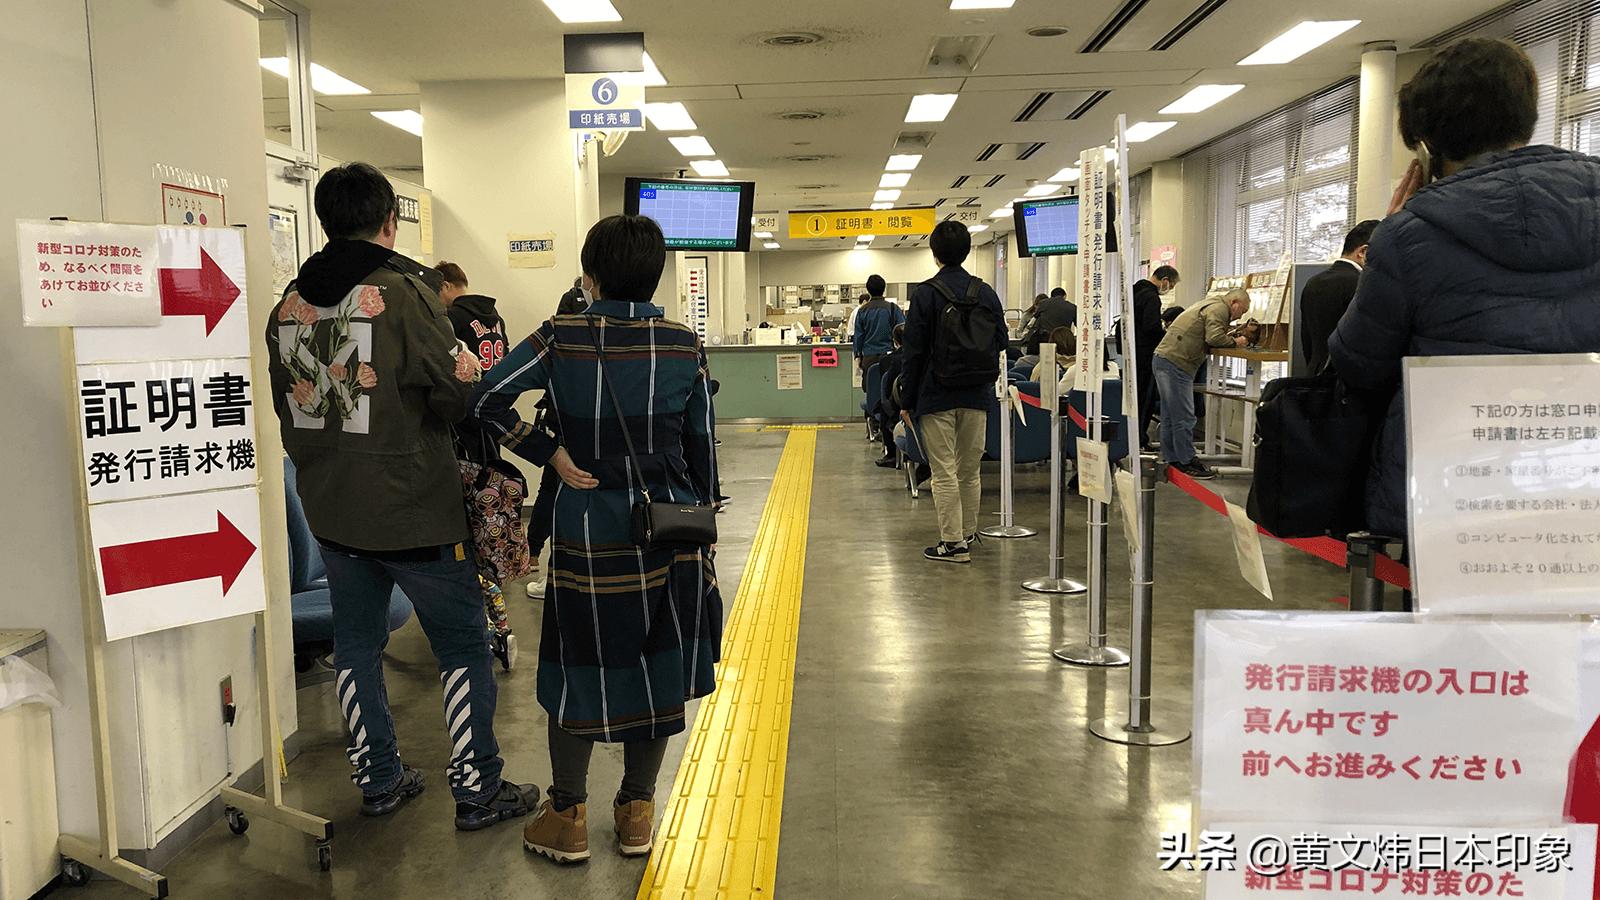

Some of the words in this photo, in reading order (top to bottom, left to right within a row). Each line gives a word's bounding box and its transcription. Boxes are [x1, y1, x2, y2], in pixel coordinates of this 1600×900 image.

[580, 112, 631, 125] 印紙売場
[758, 218, 776, 227] 受付
[836, 216, 913, 231] 証明書・閲覧
[960, 210, 978, 222] 交付
[37, 242, 142, 257] 新型コロナ対策のた
[510, 239, 553, 252] 印紙売場
[1092, 170, 1104, 331] 証明書発行請求機
[39, 261, 143, 275] め、なるべく間隔を
[40, 279, 144, 292] あけてお並びくださ
[42, 298, 53, 308] い
[479, 339, 504, 370] 99
[80, 372, 253, 439] 証明書
[1471, 404, 1600, 418] 下記の方は窓口申
[1473, 427, 1600, 441] 申請書は左右記載
[88, 438, 256, 487] 発行請求機
[1244, 662, 1530, 696] 発行請求機の入口は
[1243, 706, 1399, 737] 真ん中です
[1242, 750, 1522, 780] 前へお進みください
[1244, 865, 1525, 896] 新型コロナ対策のた
